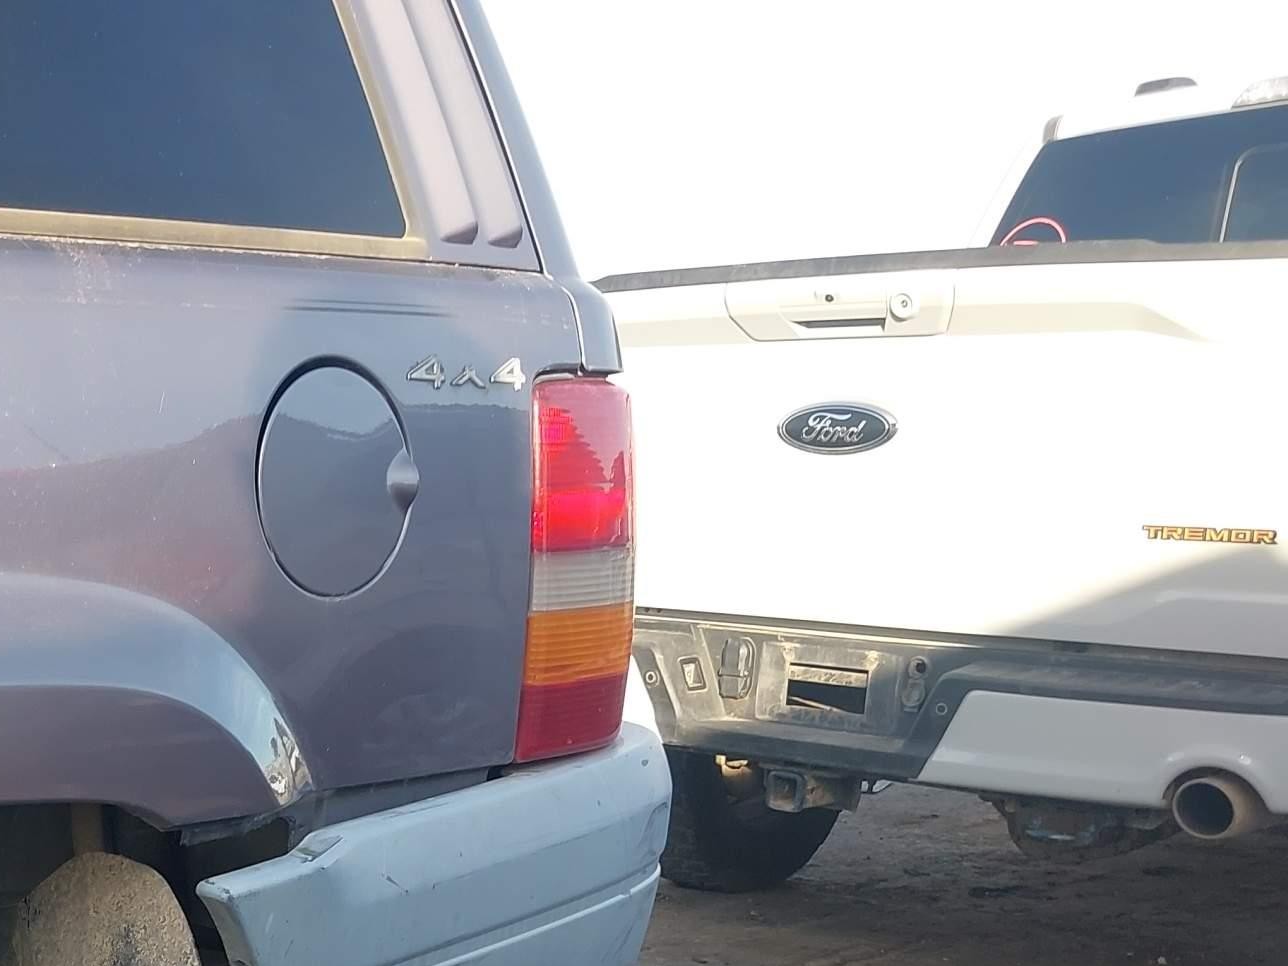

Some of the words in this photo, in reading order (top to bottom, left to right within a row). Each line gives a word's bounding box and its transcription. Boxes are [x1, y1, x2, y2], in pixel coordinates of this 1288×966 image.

[406, 355, 526, 392] 4x4
[802, 411, 867, 442] Ford
[1142, 525, 1278, 545] TREMOR
